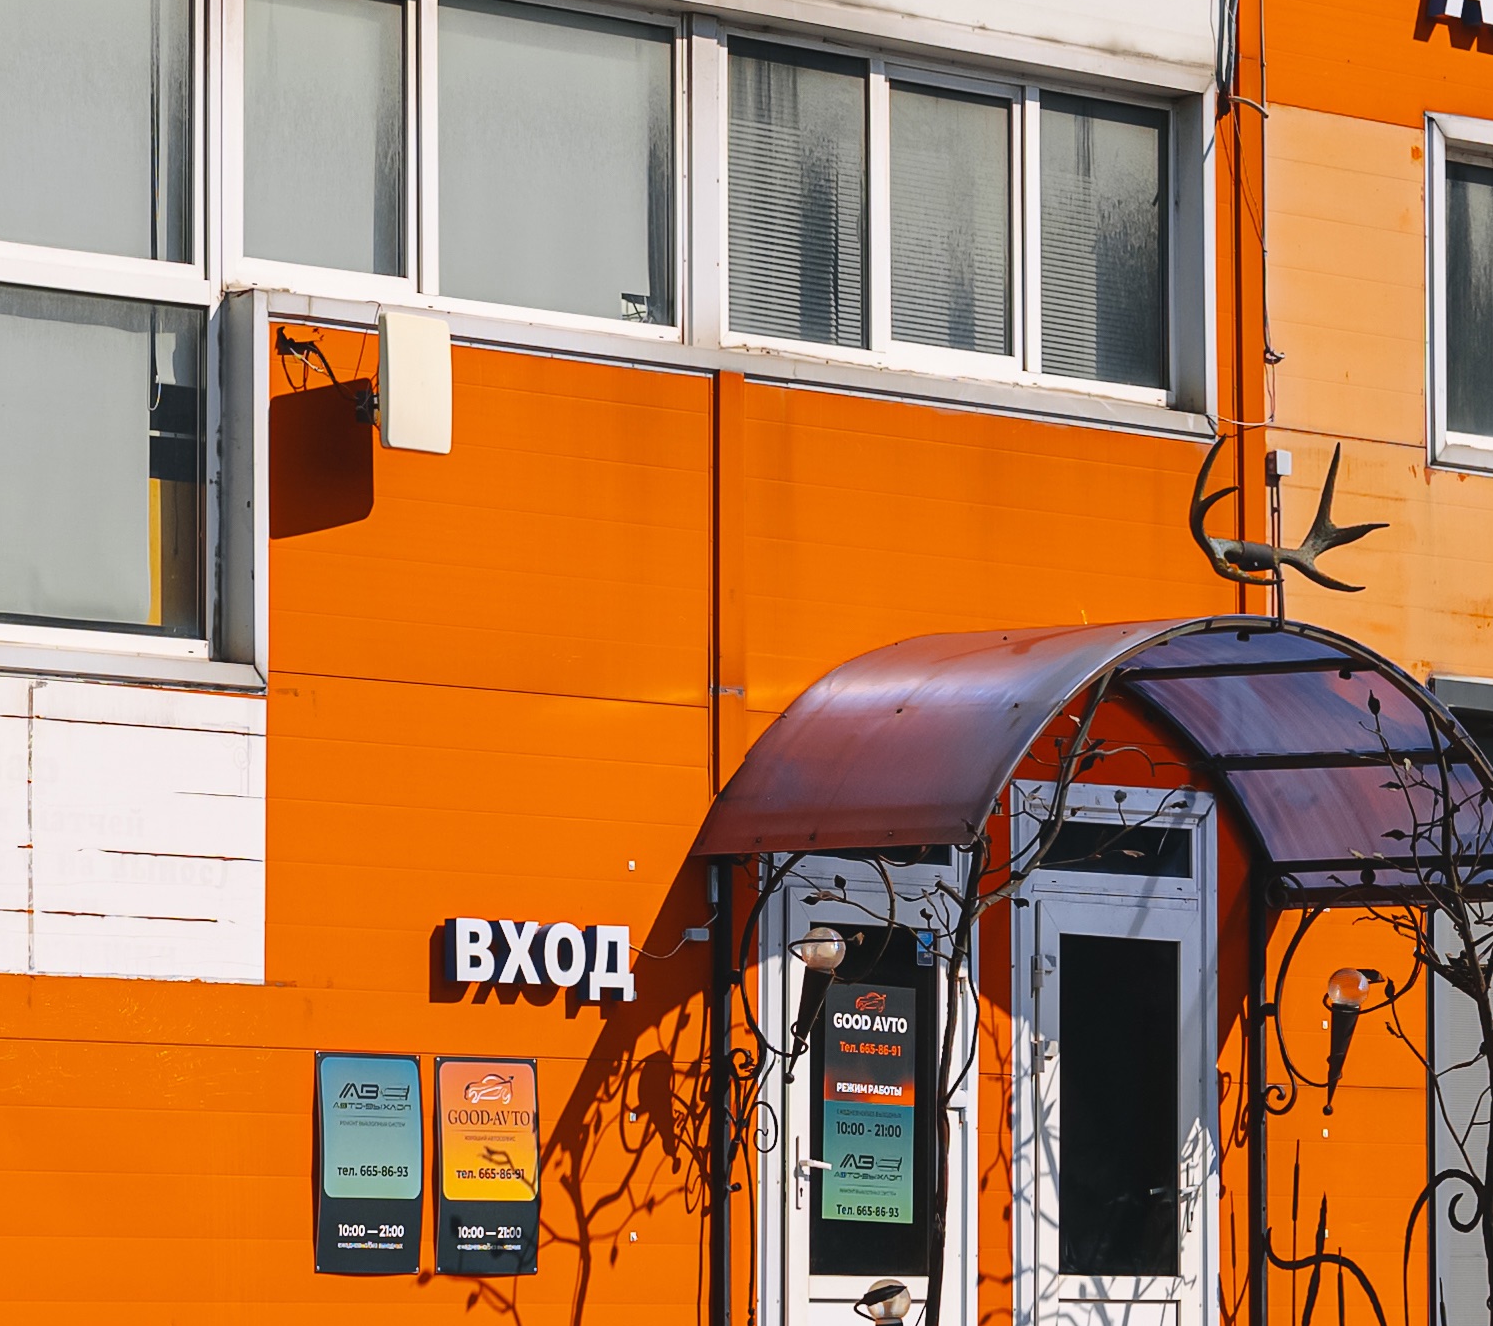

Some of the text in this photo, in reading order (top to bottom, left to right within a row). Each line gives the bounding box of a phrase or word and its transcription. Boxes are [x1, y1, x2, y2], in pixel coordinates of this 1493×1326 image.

[452, 917, 636, 1002] ВХОД
[833, 1012, 908, 1034] GOOD AVTO
[839, 1040, 902, 1057] Тел. 665-86-91
[836, 1081, 903, 1096] РЕЖИМ РАБОТЫ
[447, 1109, 531, 1126] GOOD-AVTO
[836, 1121, 865, 1136] 10:00
[874, 1124, 902, 1138] 21:00
[337, 1165, 409, 1178] тел. 665-86-93
[456, 1168, 525, 1180] тел. 665-86-91
[836, 1204, 900, 1218] Тел. 665-86-93
[338, 1224, 366, 1237] 10:00
[379, 1224, 405, 1238] 21:00
[457, 1226, 485, 1239] 10:00
[497, 1226, 522, 1239] 21:00
